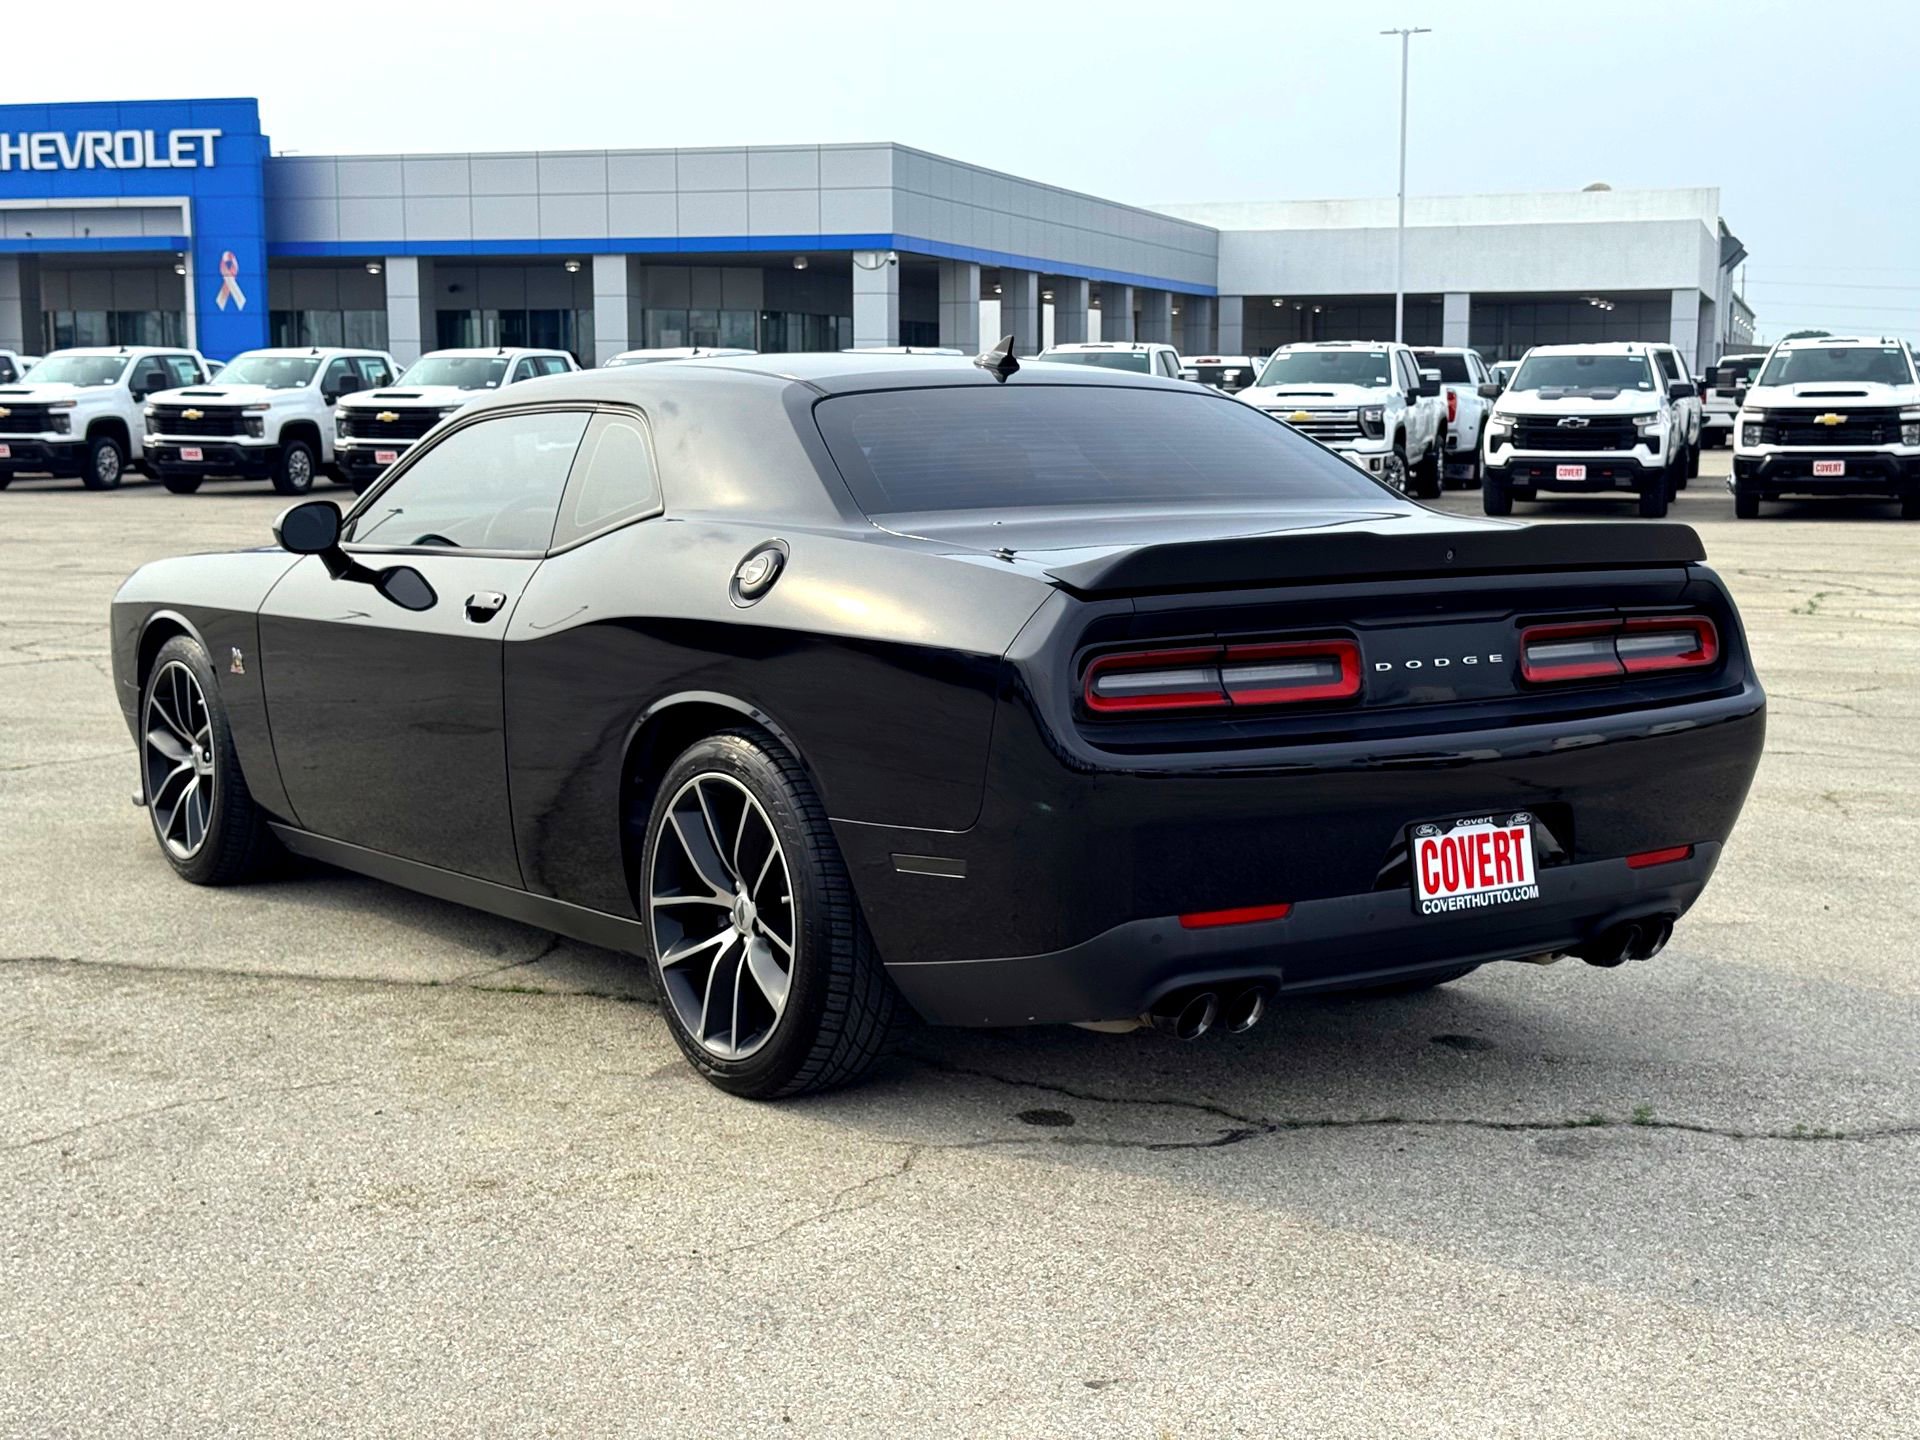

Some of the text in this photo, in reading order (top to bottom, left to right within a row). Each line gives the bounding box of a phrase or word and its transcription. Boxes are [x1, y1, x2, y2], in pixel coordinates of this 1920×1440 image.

[1558, 468, 1583, 477] COVERT
[1375, 654, 1503, 672] DODGE
[1456, 816, 1493, 827] Covert
[1421, 828, 1524, 895] COVERT
[1422, 885, 1539, 915] COVERTHUTTO.COM
